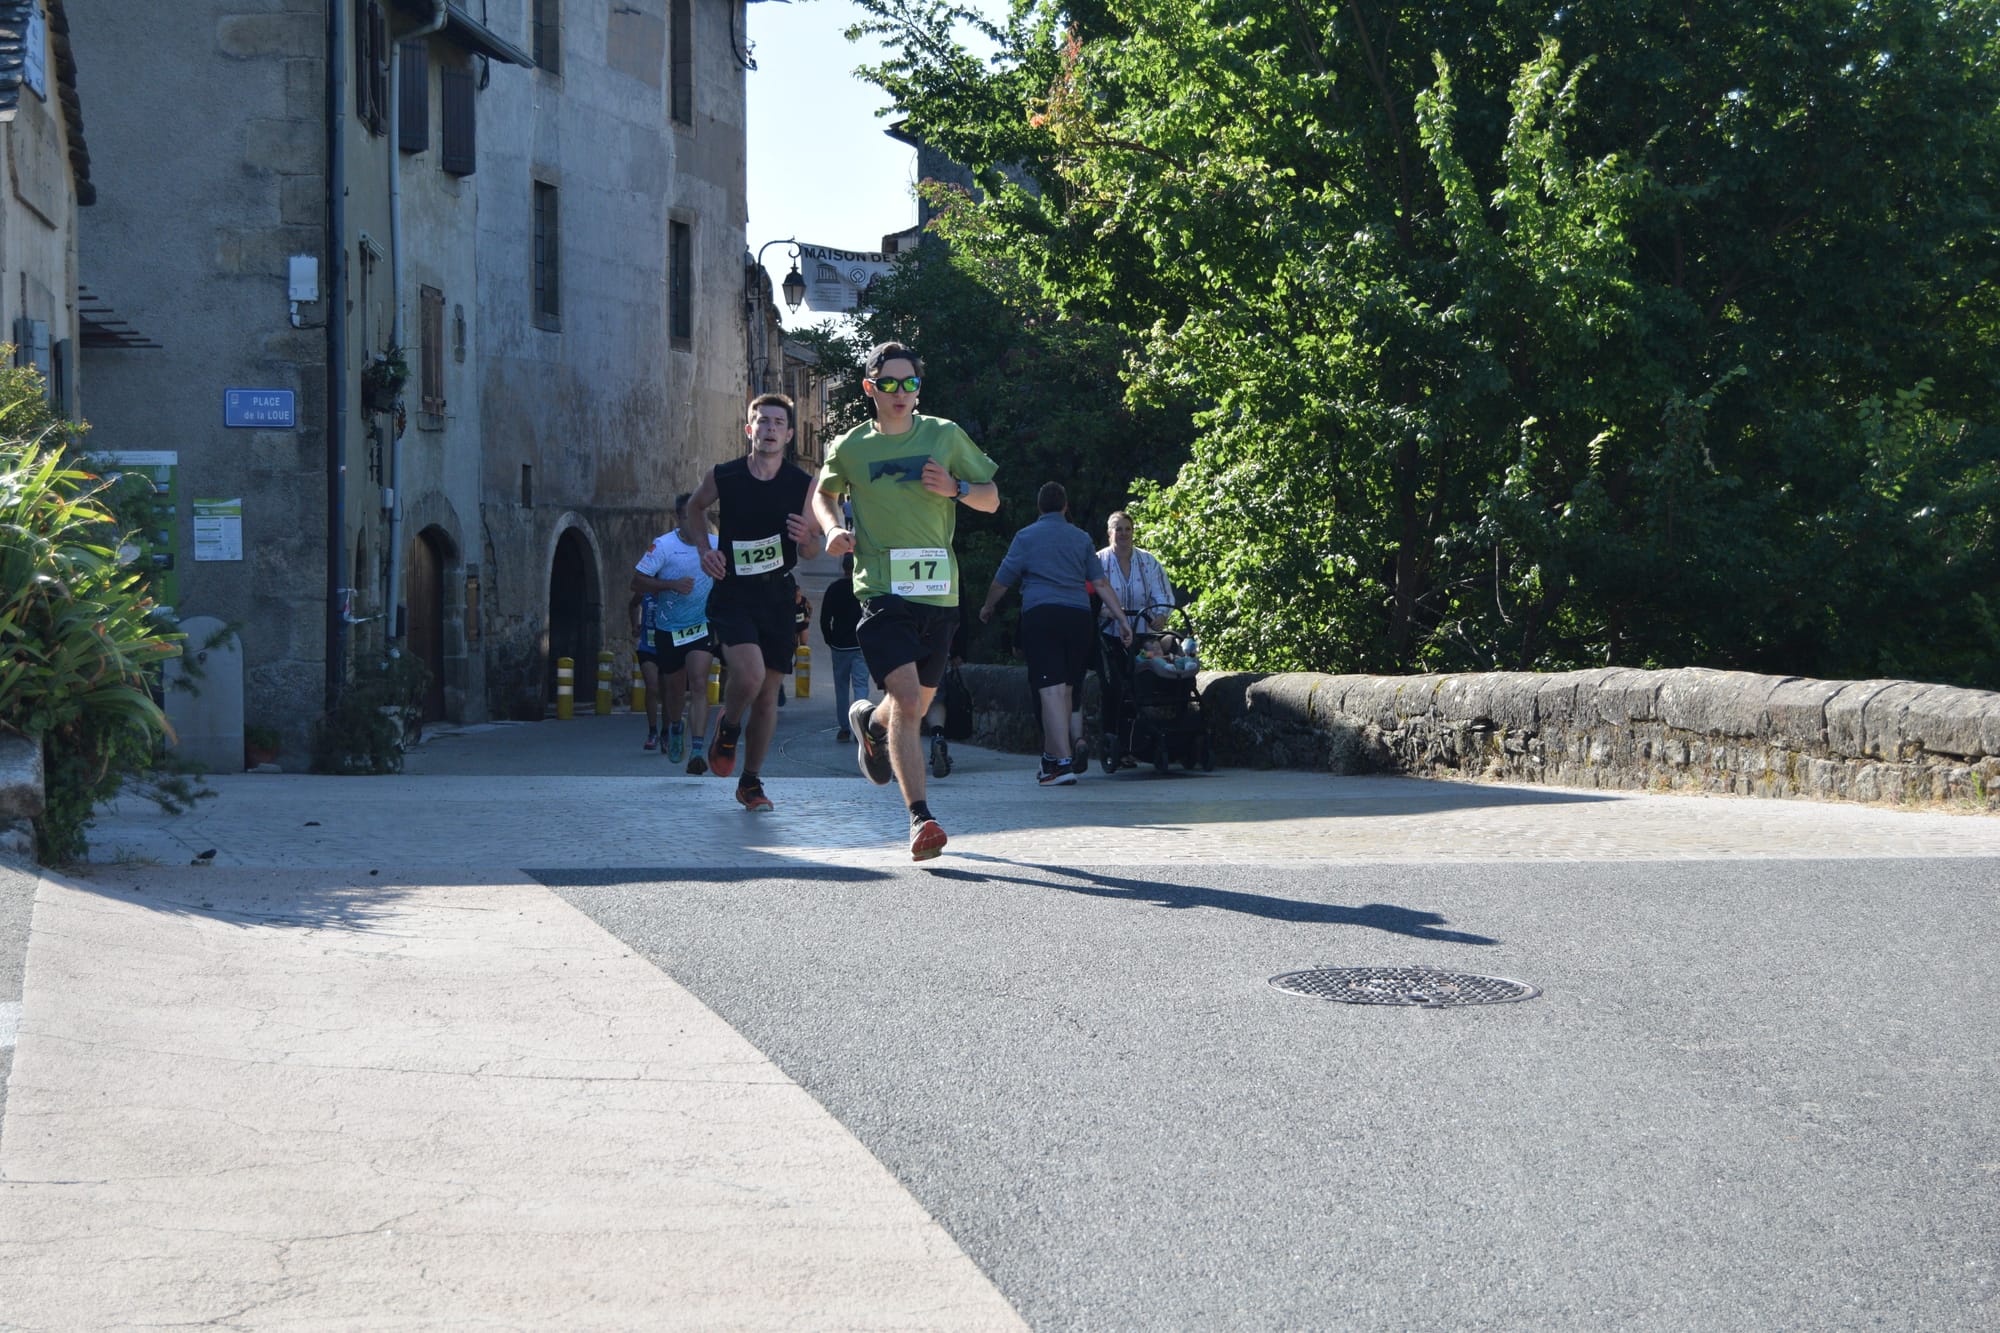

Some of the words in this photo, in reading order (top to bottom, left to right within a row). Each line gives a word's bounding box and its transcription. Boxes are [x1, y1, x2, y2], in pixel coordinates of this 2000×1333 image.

[804, 247, 867, 263] MAISON
[871, 254, 891, 263] DE
[252, 396, 281, 407] PLACE
[243, 410, 255, 420] de
[256, 410, 265, 420] la
[267, 410, 290, 420] LOUE
[741, 546, 777, 564] 129
[909, 560, 938, 580] 17
[677, 624, 702, 639] 147
